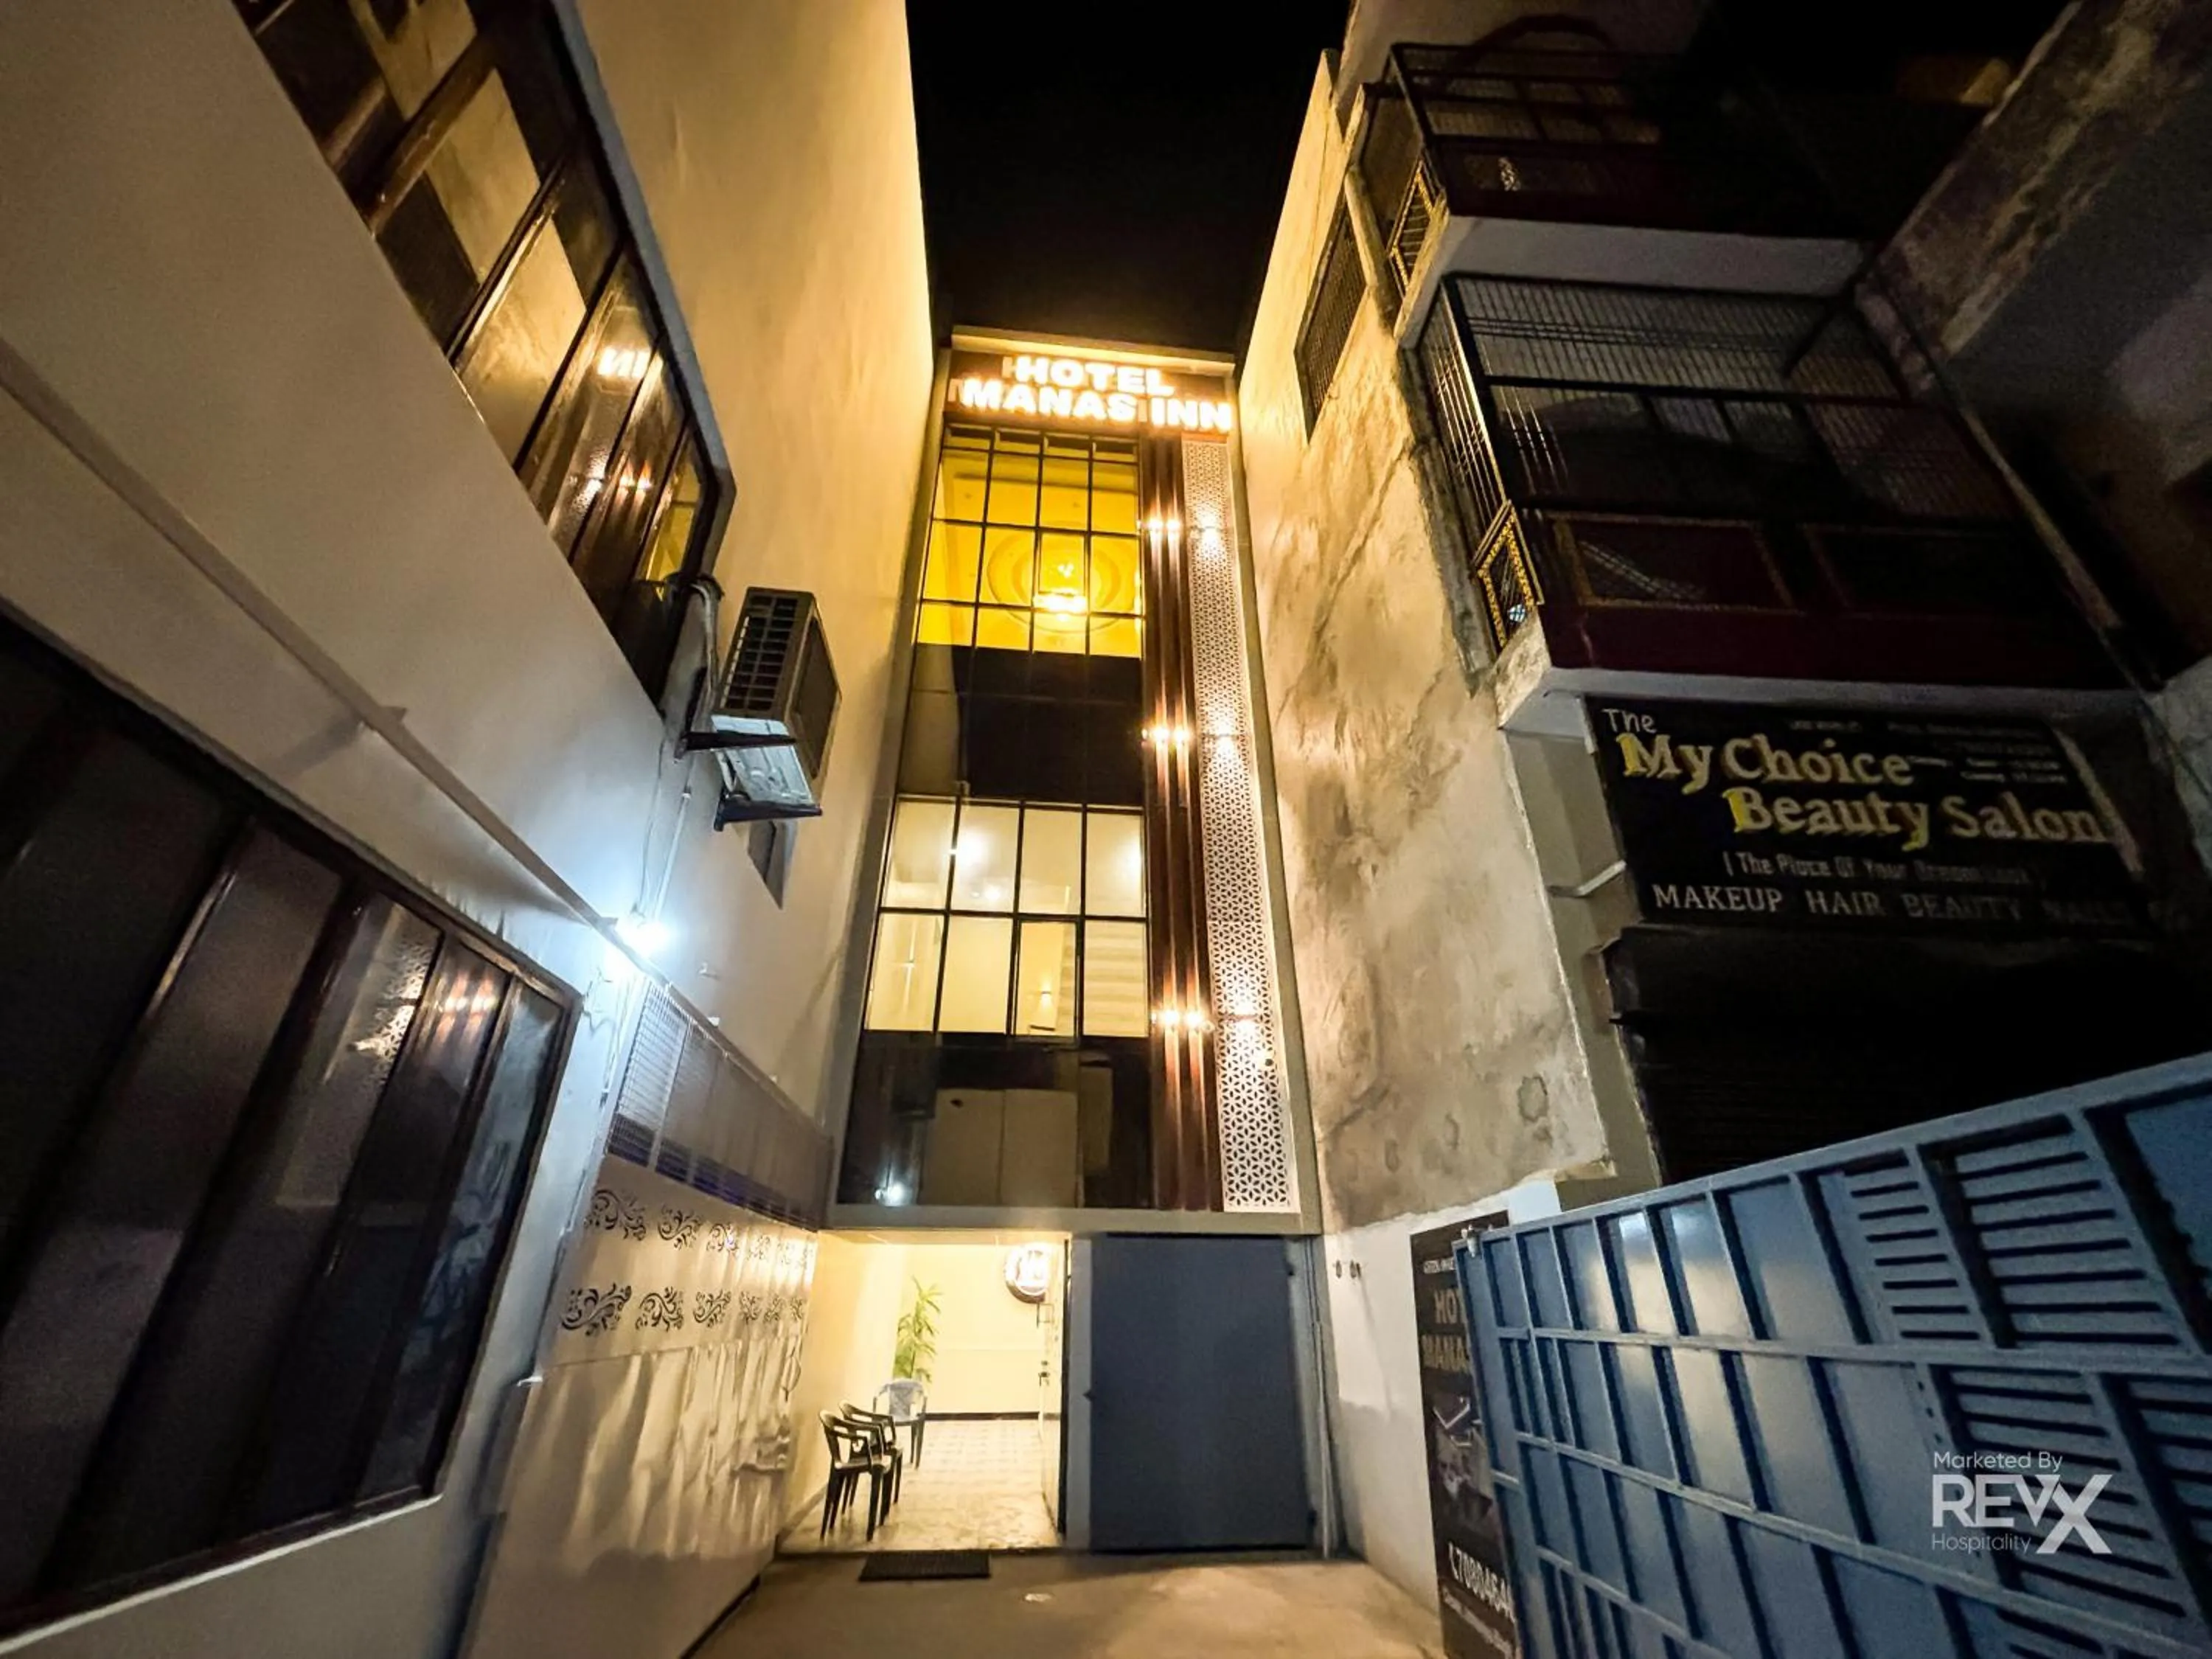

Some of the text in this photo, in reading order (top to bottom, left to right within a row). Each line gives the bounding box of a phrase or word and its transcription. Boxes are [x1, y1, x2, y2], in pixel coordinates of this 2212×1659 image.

[1014, 355, 1175, 397] HOTEL
[961, 377, 1232, 432] MANAS INN
[1601, 707, 1658, 734] The
[1615, 731, 1915, 796] My Choice
[1722, 785, 2112, 853] Beauty Salon
[1650, 883, 1784, 913] MAKEUP
[1804, 889, 1888, 917] HAIR
